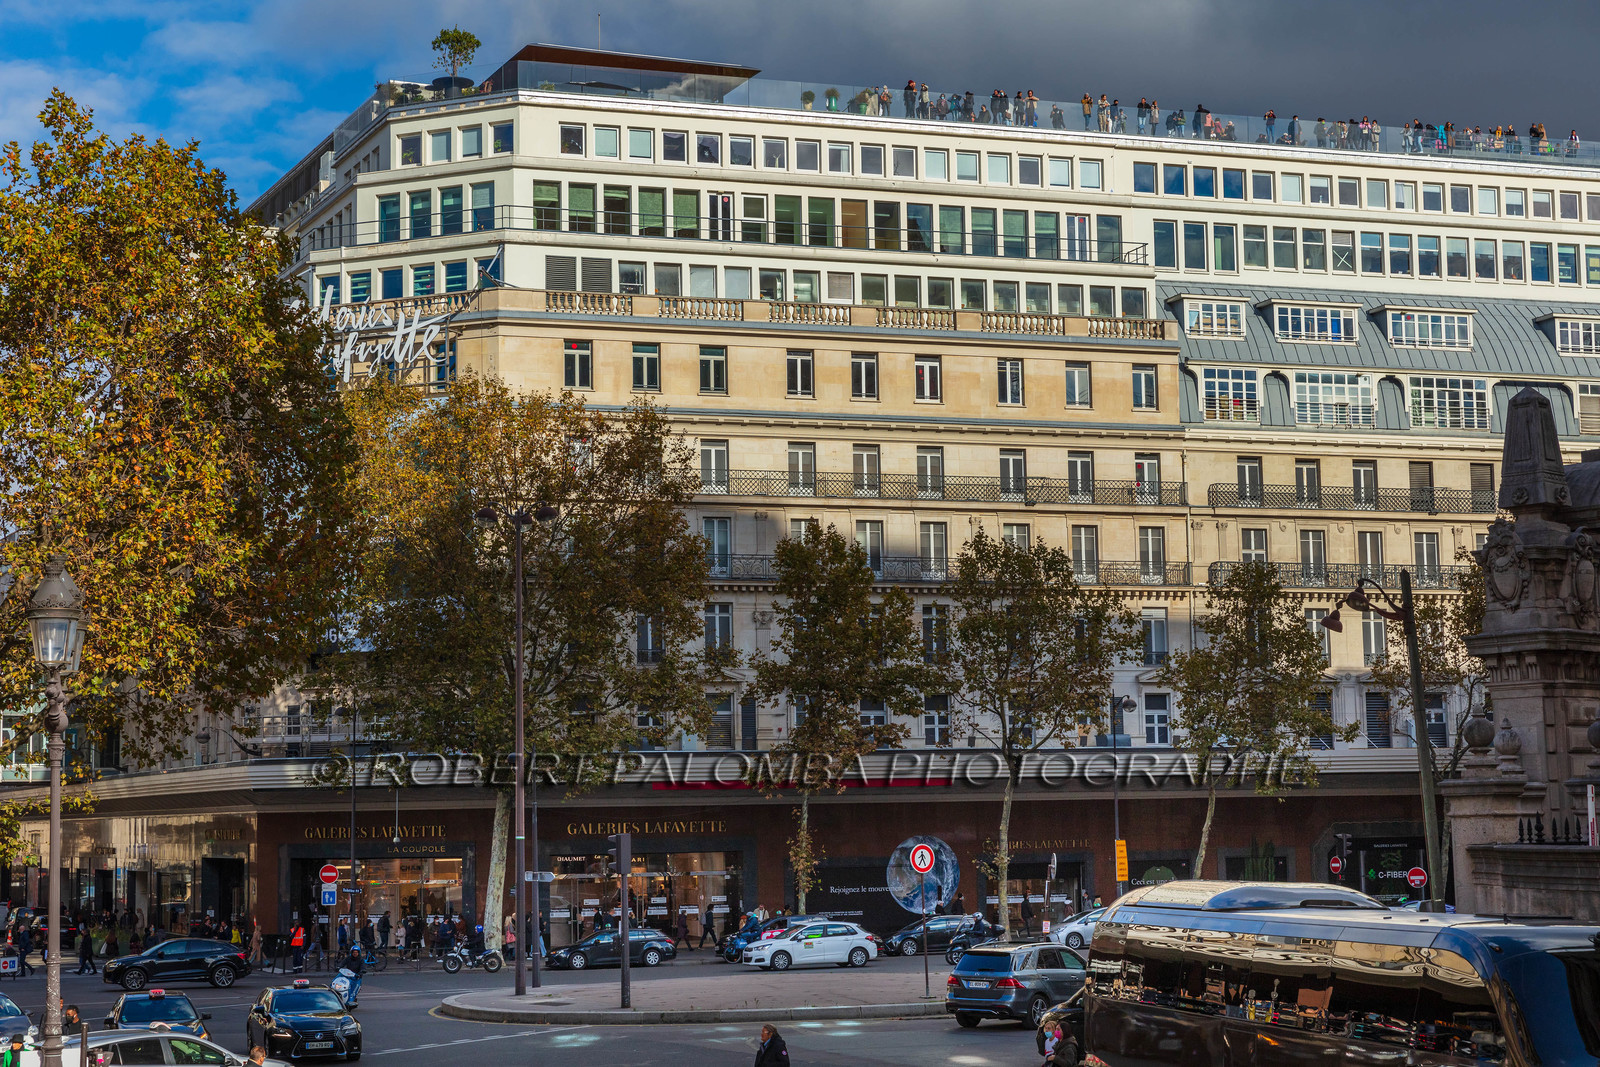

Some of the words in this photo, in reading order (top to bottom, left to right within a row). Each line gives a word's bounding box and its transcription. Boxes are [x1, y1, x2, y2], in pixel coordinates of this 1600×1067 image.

[372, 825, 446, 838] LAFAYETTE
[567, 822, 640, 835] GALERIES
[645, 820, 727, 834] LAFAYETTE
[402, 845, 446, 853] COUPOLE
[982, 839, 1032, 850] GALRIES
[829, 885, 860, 895] Rejoignez
[861, 885, 867, 893] le
